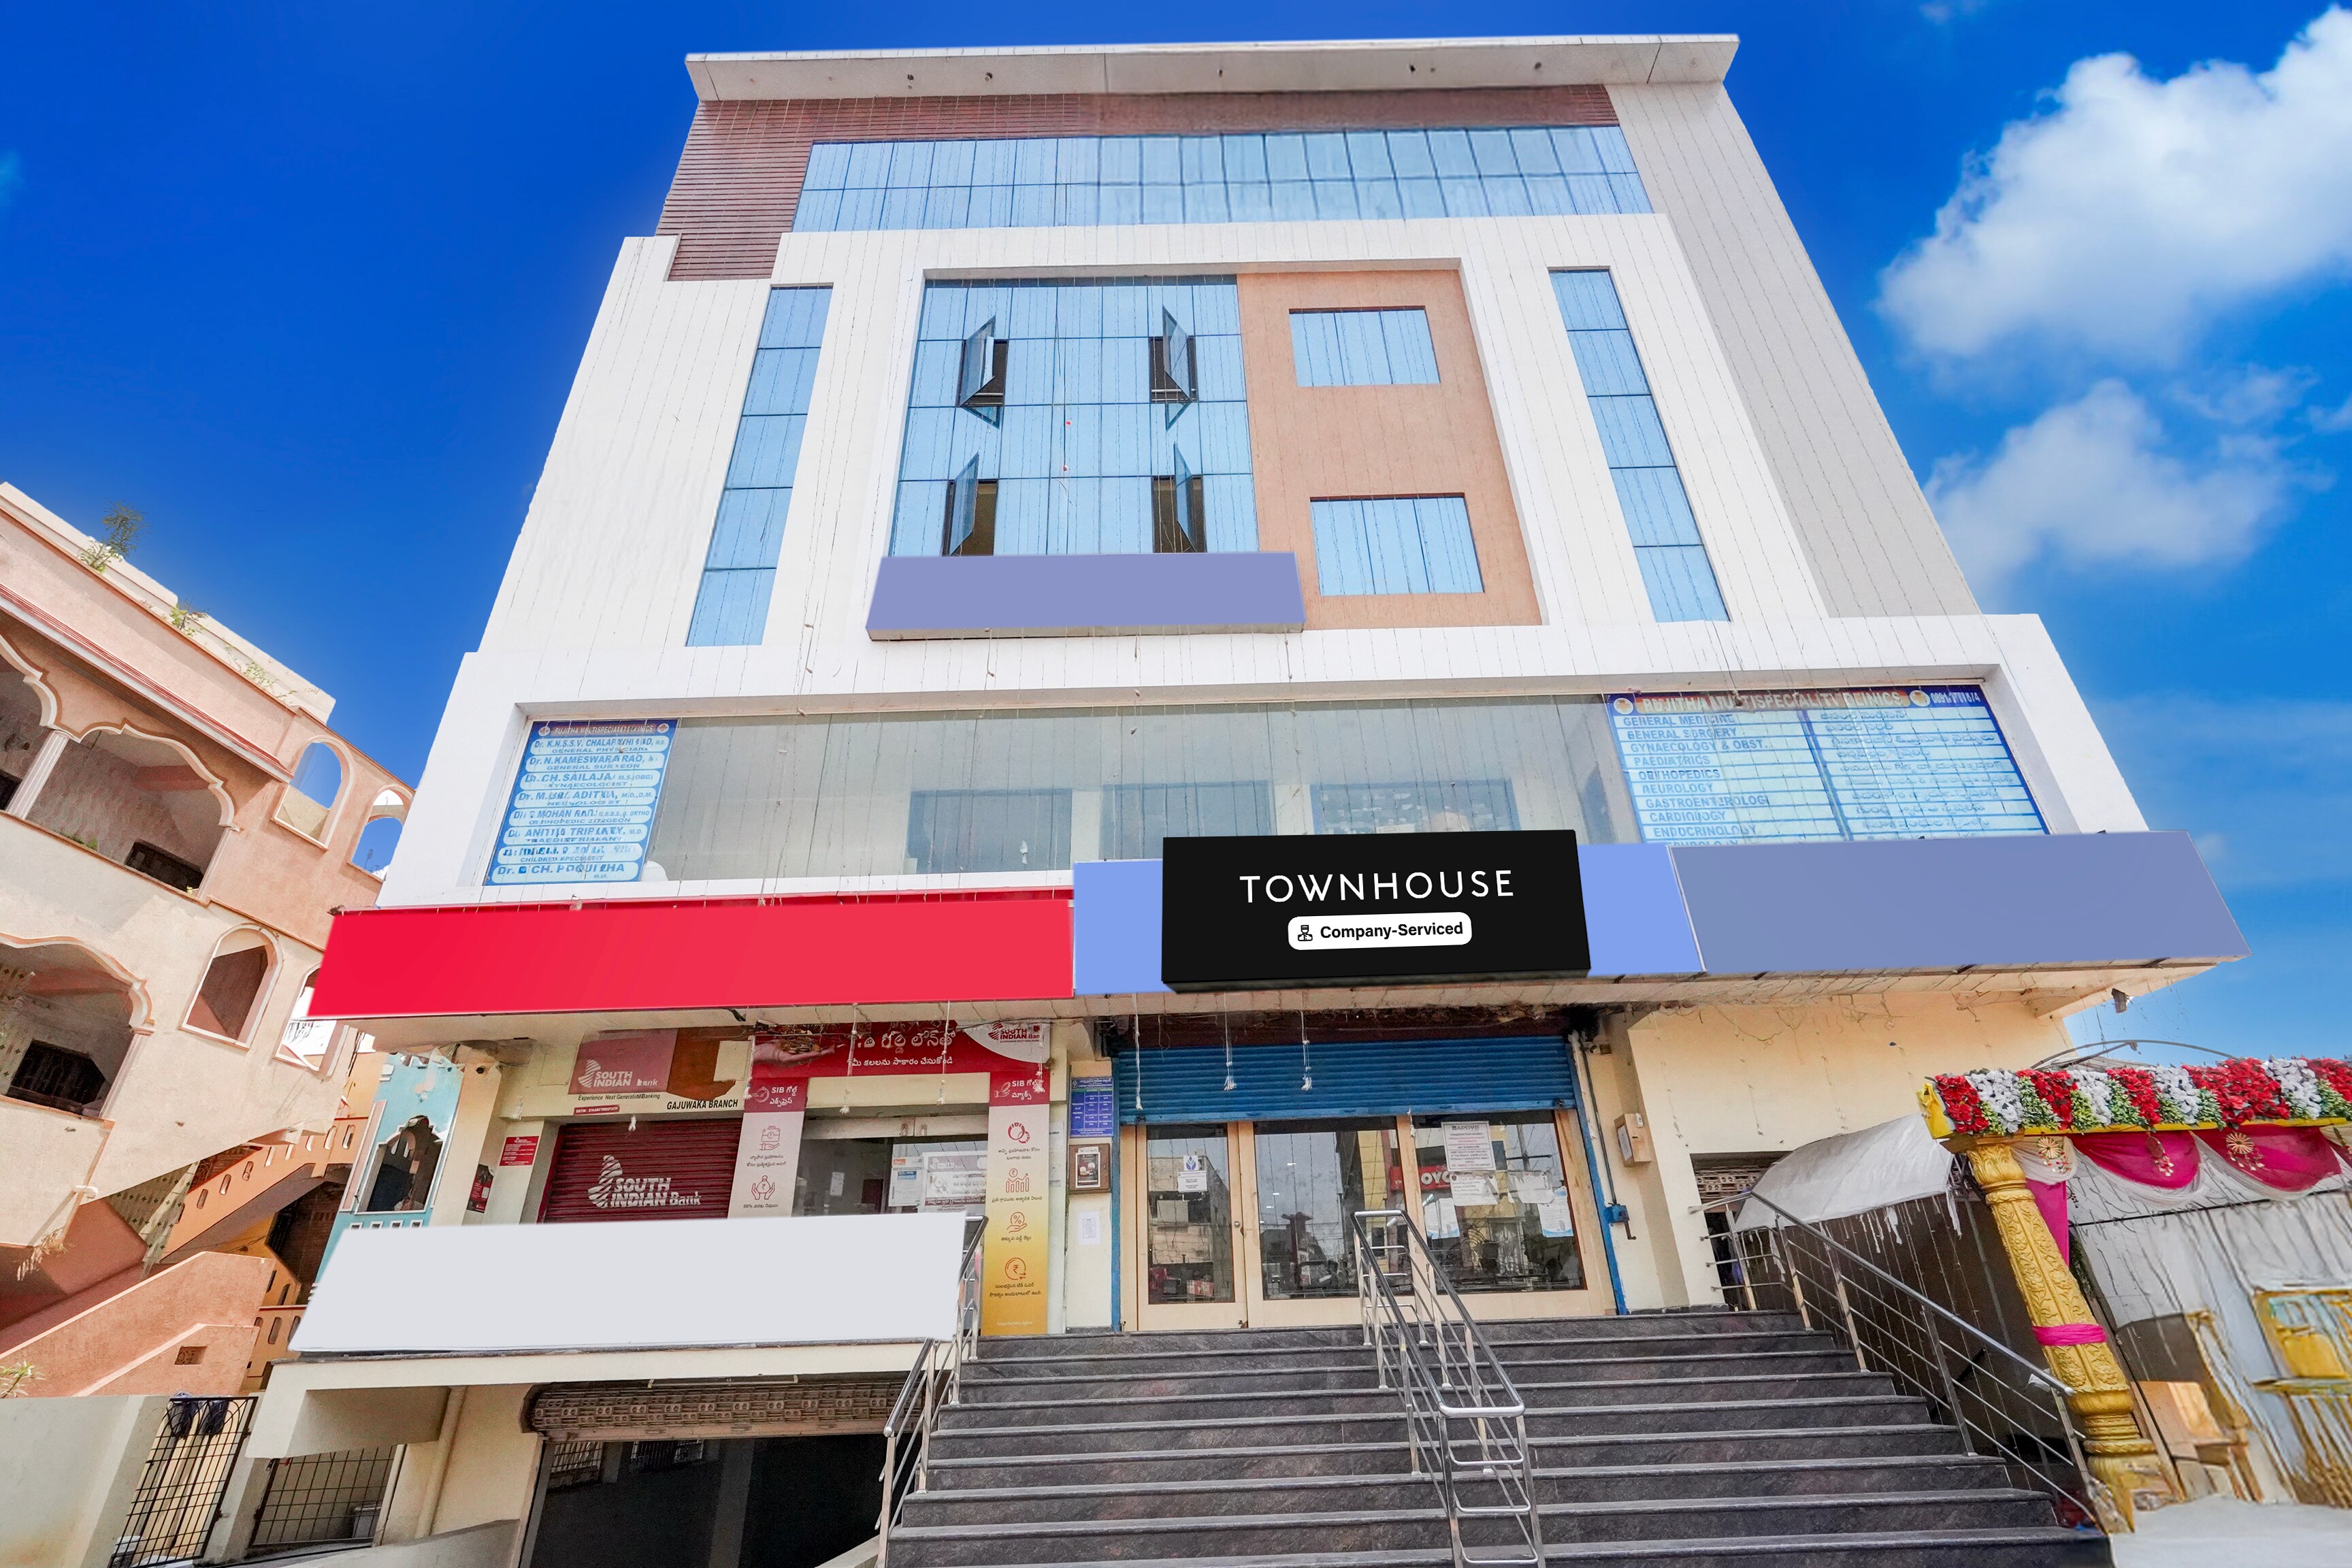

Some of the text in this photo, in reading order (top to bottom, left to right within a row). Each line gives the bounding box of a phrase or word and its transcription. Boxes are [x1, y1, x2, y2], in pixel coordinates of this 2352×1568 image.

[1711, 689, 1841, 710] MUTISPECIALITY
[1624, 715, 1676, 726] GENERAL
[1631, 742, 1716, 753] GYNAECOLOGY
[1722, 741, 1729, 750] &
[529, 757, 542, 766] Dr.
[1634, 755, 1711, 766] PAEDIATRICS
[537, 810, 572, 818] MOHAN
[497, 866, 514, 875] Dr.
[1240, 870, 1514, 904] TOWNHOUSE
[1320, 921, 1464, 941] Company-Serviced
[595, 1071, 633, 1079] SOUTH
[593, 1079, 631, 1088] INDIAN
[667, 1099, 738, 1111] GAJUWAKA BRANCH
[612, 1177, 671, 1192] SOUTH
[610, 1192, 702, 1207] INDIAN Bank
